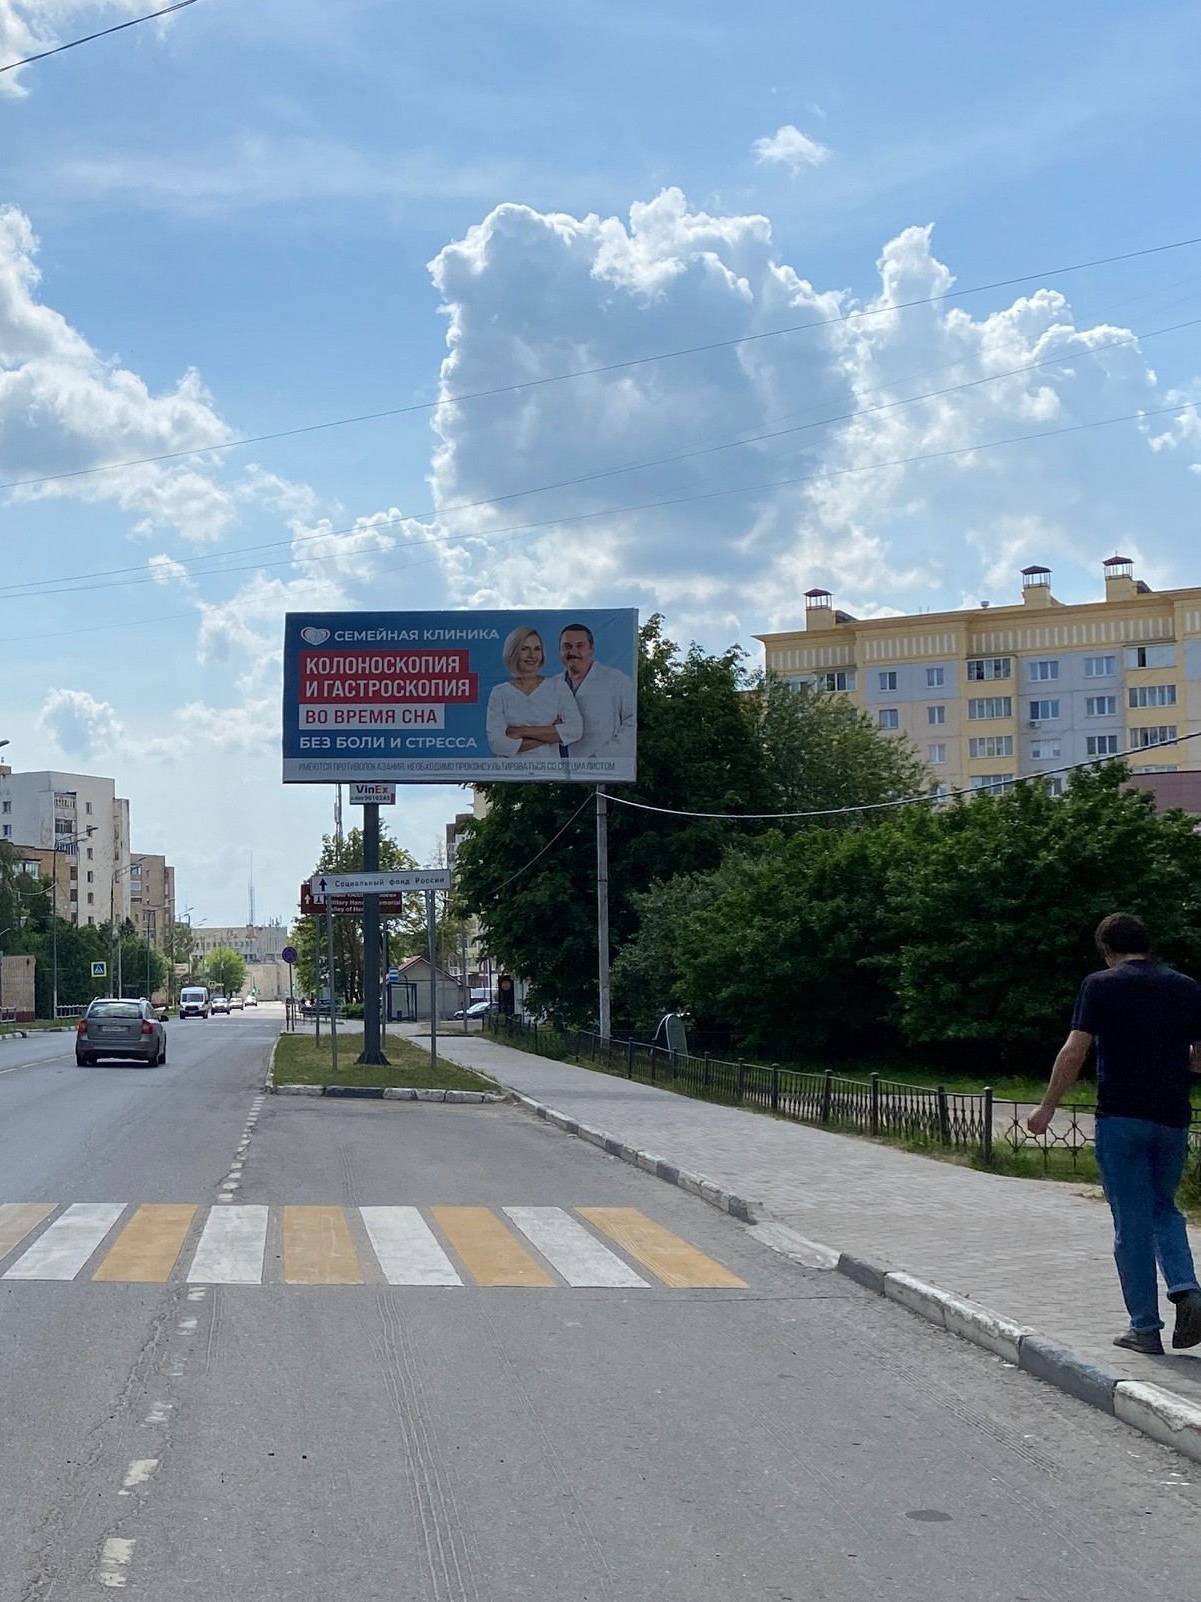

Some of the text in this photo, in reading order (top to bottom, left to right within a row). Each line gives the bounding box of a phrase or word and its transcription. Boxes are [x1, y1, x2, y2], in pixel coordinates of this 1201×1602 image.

[334, 628, 500, 641] СЕМЕЙНАЯ КЛИНИКА
[306, 656, 460, 674] КОЛОНОСКОПИЯ
[305, 679, 470, 697] И ГАСТРОСКОПИЯ
[305, 709, 438, 724] ВО ВРЕМЯ СНА
[299, 736, 478, 749] БЕЗ БОЛИ И СТРЕССА
[298, 762, 333, 771] ИМЕЮТСЯ
[407, 762, 455, 771] НЕОБХОДИМО
[455, 762, 546, 771] ПРОКОНСУЛЬТИРОВАТЬСЯ
[547, 762, 556, 770] СО
[557, 762, 616, 770] СПЕЦИАЛИСТОМ
[355, 785, 388, 793] VinEx
[335, 880, 385, 888] Социальный
[415, 877, 445, 885] России
